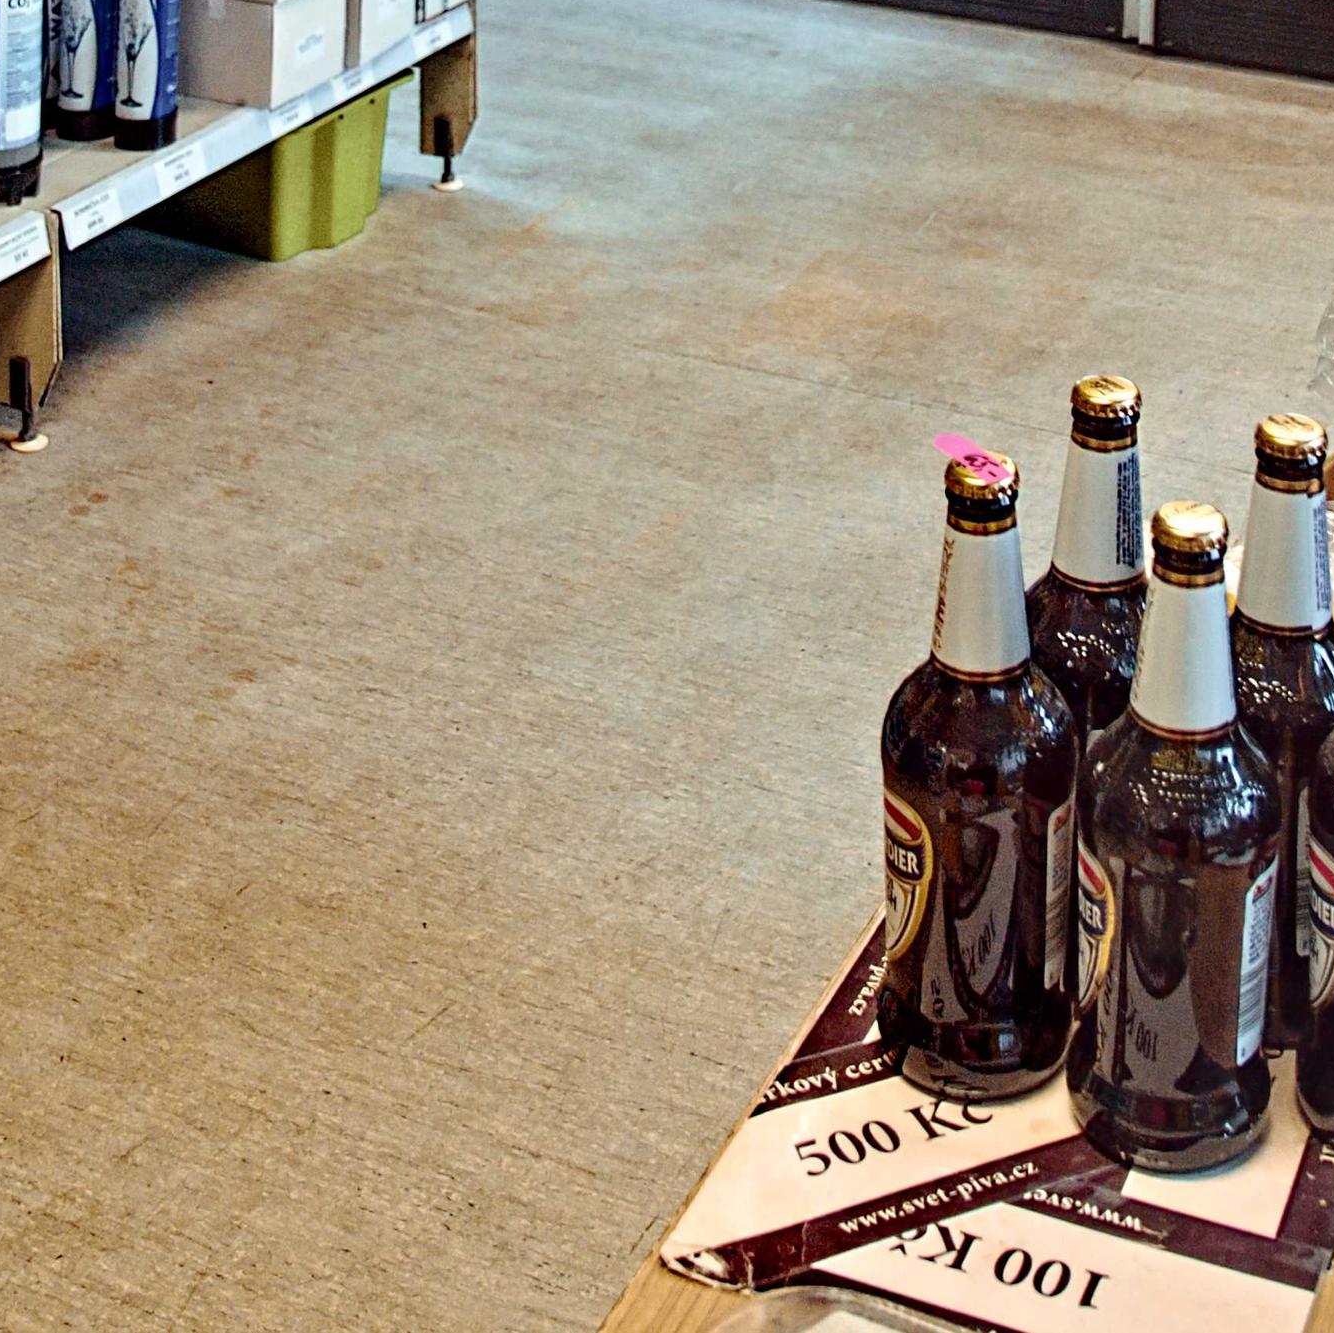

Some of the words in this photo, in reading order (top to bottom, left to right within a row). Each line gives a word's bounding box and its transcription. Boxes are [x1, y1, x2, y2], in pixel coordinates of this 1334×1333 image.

[795, 1121, 900, 1176] 500
[837, 1159, 1040, 1237] www.svet-piva.cz
[995, 1248, 1113, 1311] 100
